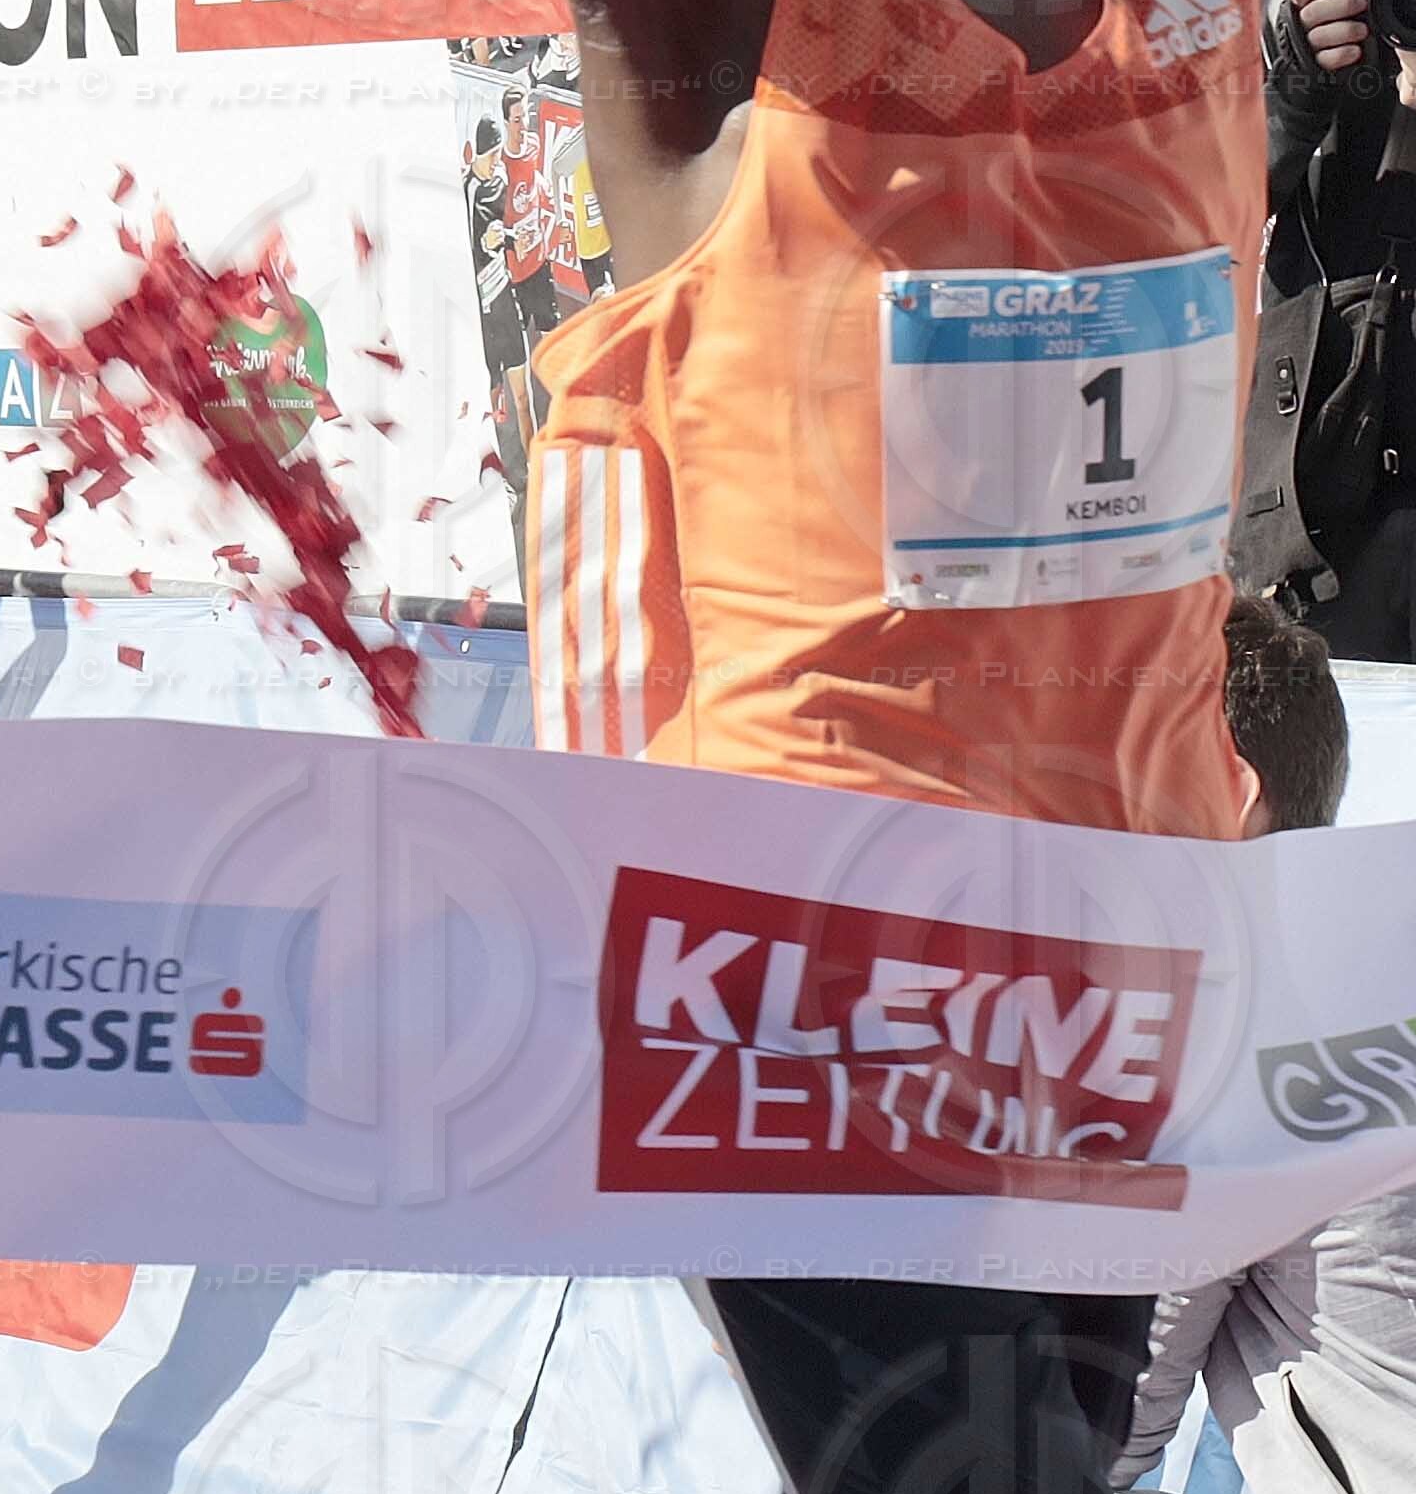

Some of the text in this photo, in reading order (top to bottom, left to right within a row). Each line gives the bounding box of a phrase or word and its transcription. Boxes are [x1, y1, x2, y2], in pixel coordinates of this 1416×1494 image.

[1148, 7, 1243, 69] adidas
[994, 283, 1103, 317] GRAZ
[969, 320, 1072, 339] MARATHON
[1080, 366, 1136, 485] 1
[1065, 494, 1148, 521] KEMBOI
[634, 915, 1176, 1104] KLEINE
